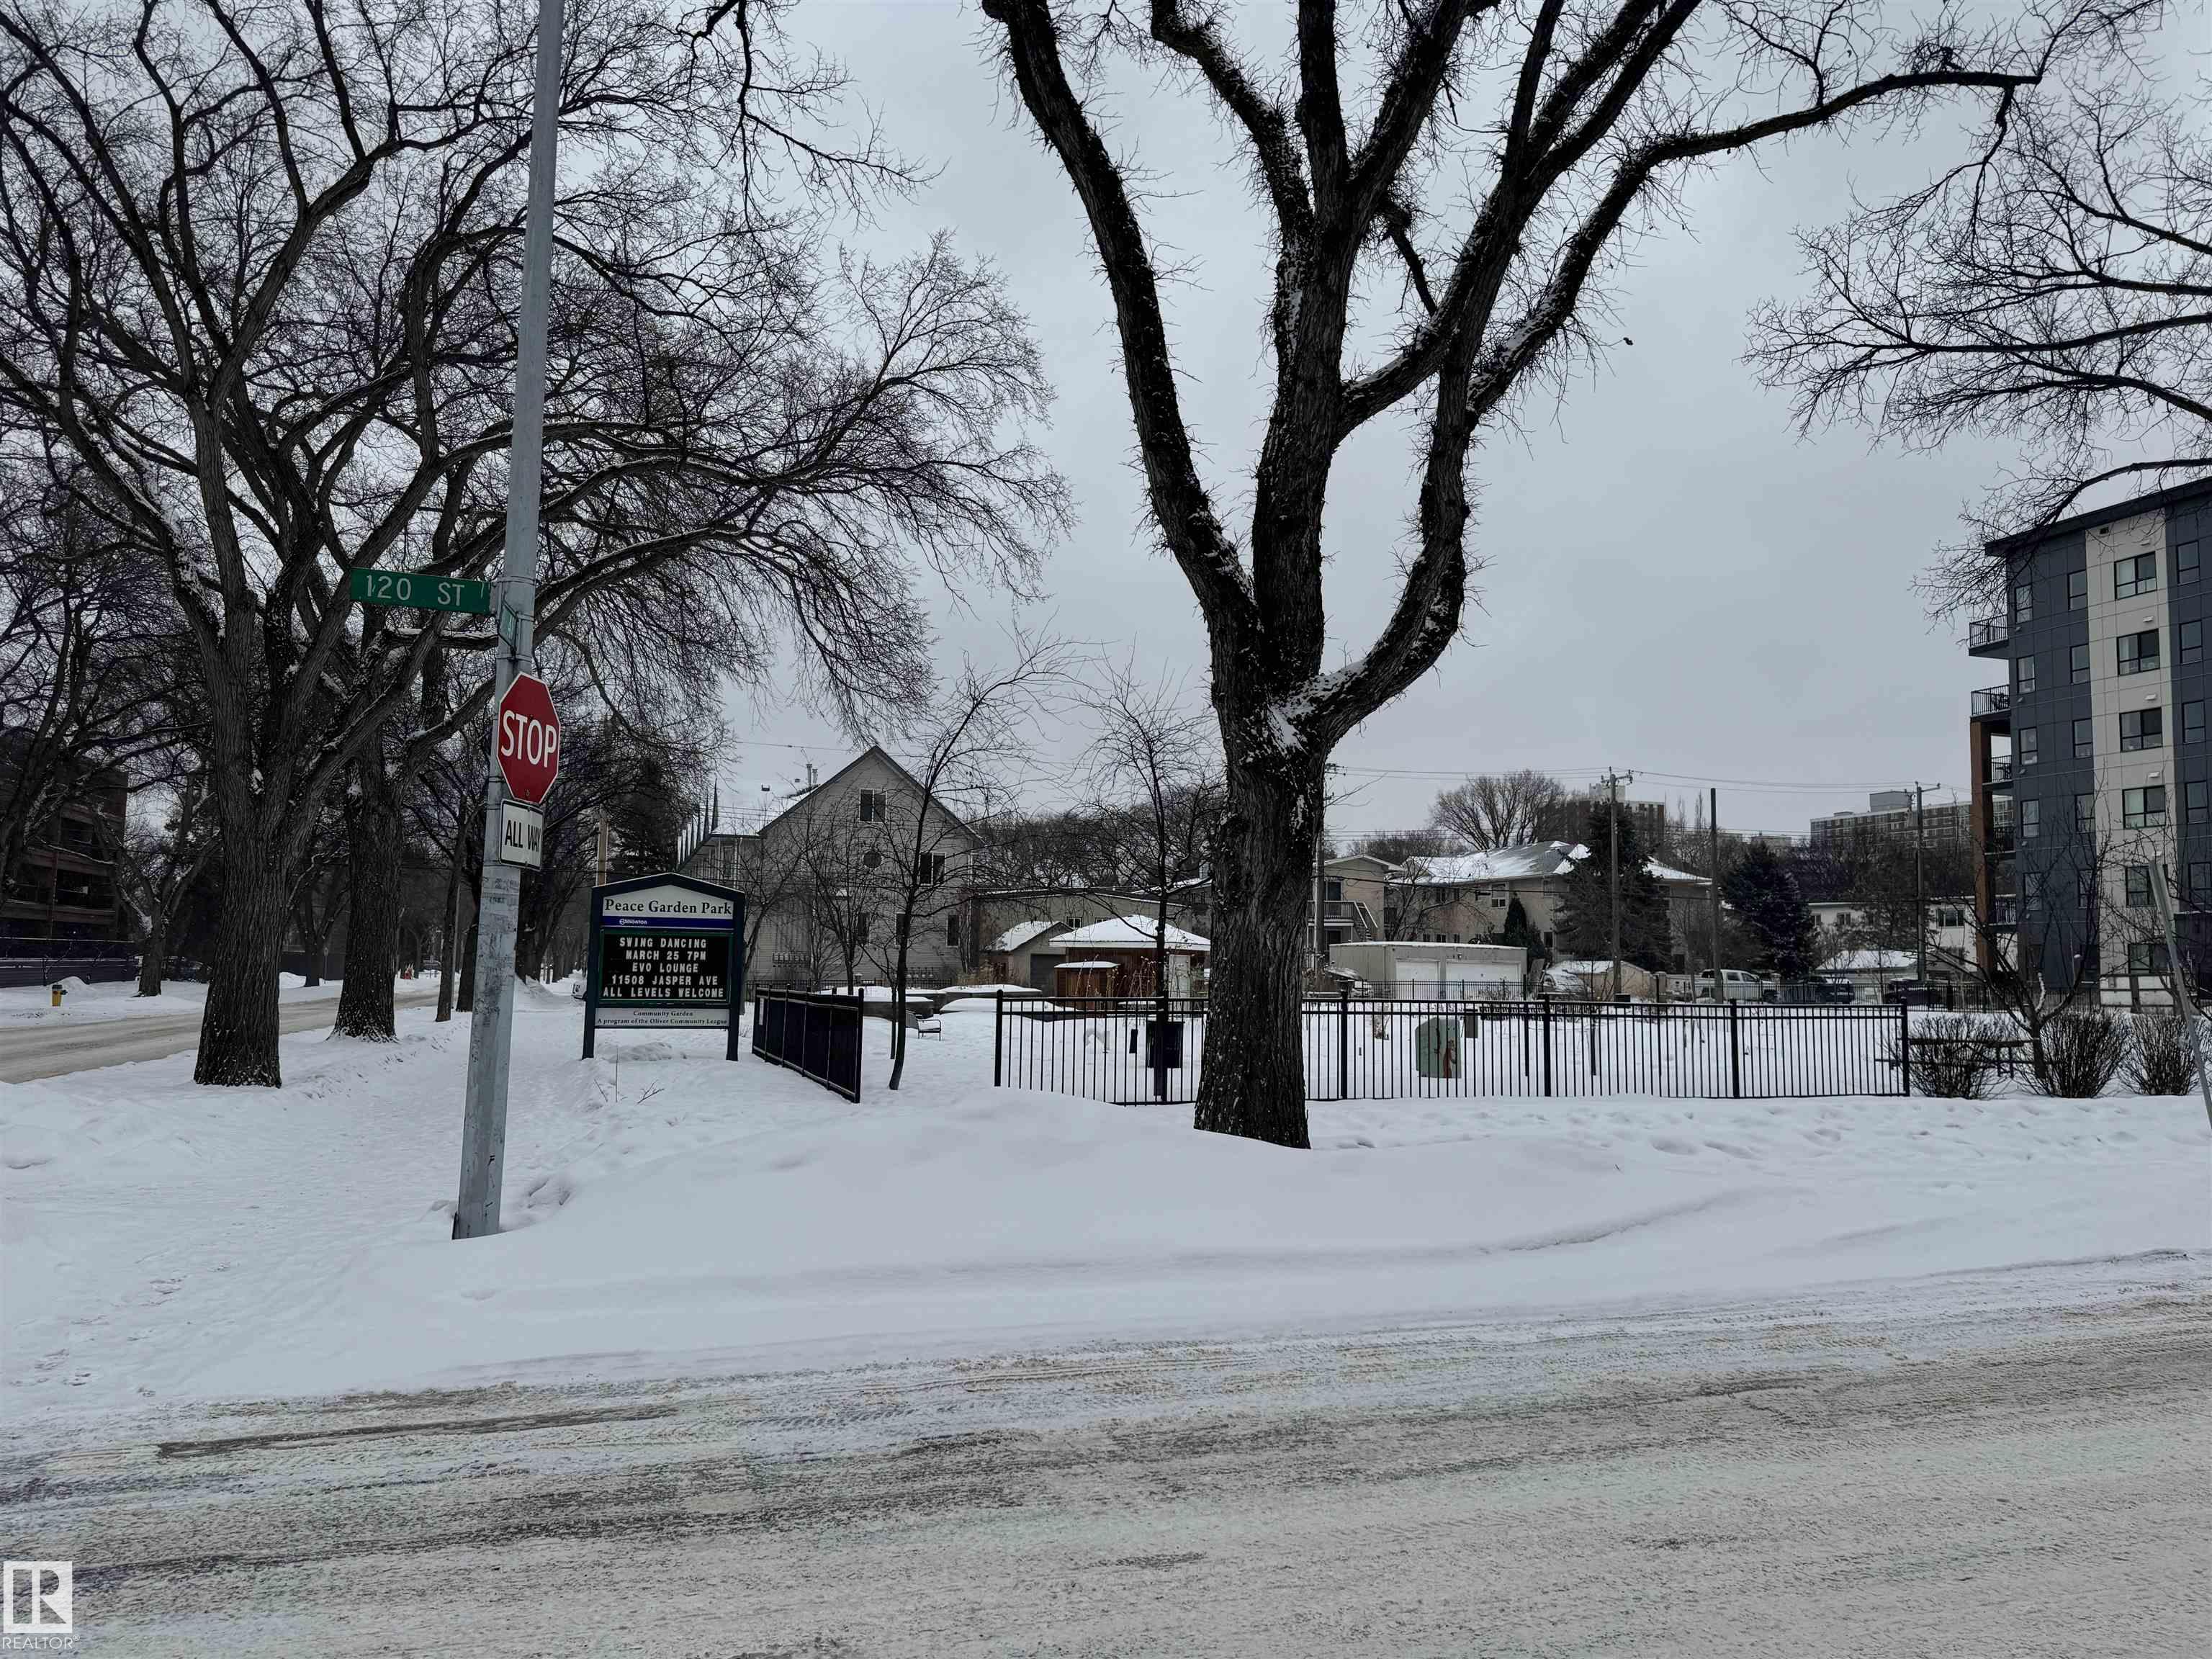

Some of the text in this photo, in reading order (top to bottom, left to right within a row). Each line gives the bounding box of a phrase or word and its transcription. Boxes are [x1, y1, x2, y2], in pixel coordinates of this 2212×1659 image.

[367, 575, 465, 606] 120 ST
[500, 710, 558, 768] STOP
[505, 819, 541, 853] ALL WAY
[604, 899, 732, 914] Peace Garden Park
[619, 937, 706, 948] SWING DANCING
[625, 950, 706, 961] MARCH 25 7PM
[632, 962, 698, 973] EVO LOUNGE
[612, 974, 718, 986] 11508 JASPER AVE
[603, 986, 724, 998] ALL LEVELS WELCOME
